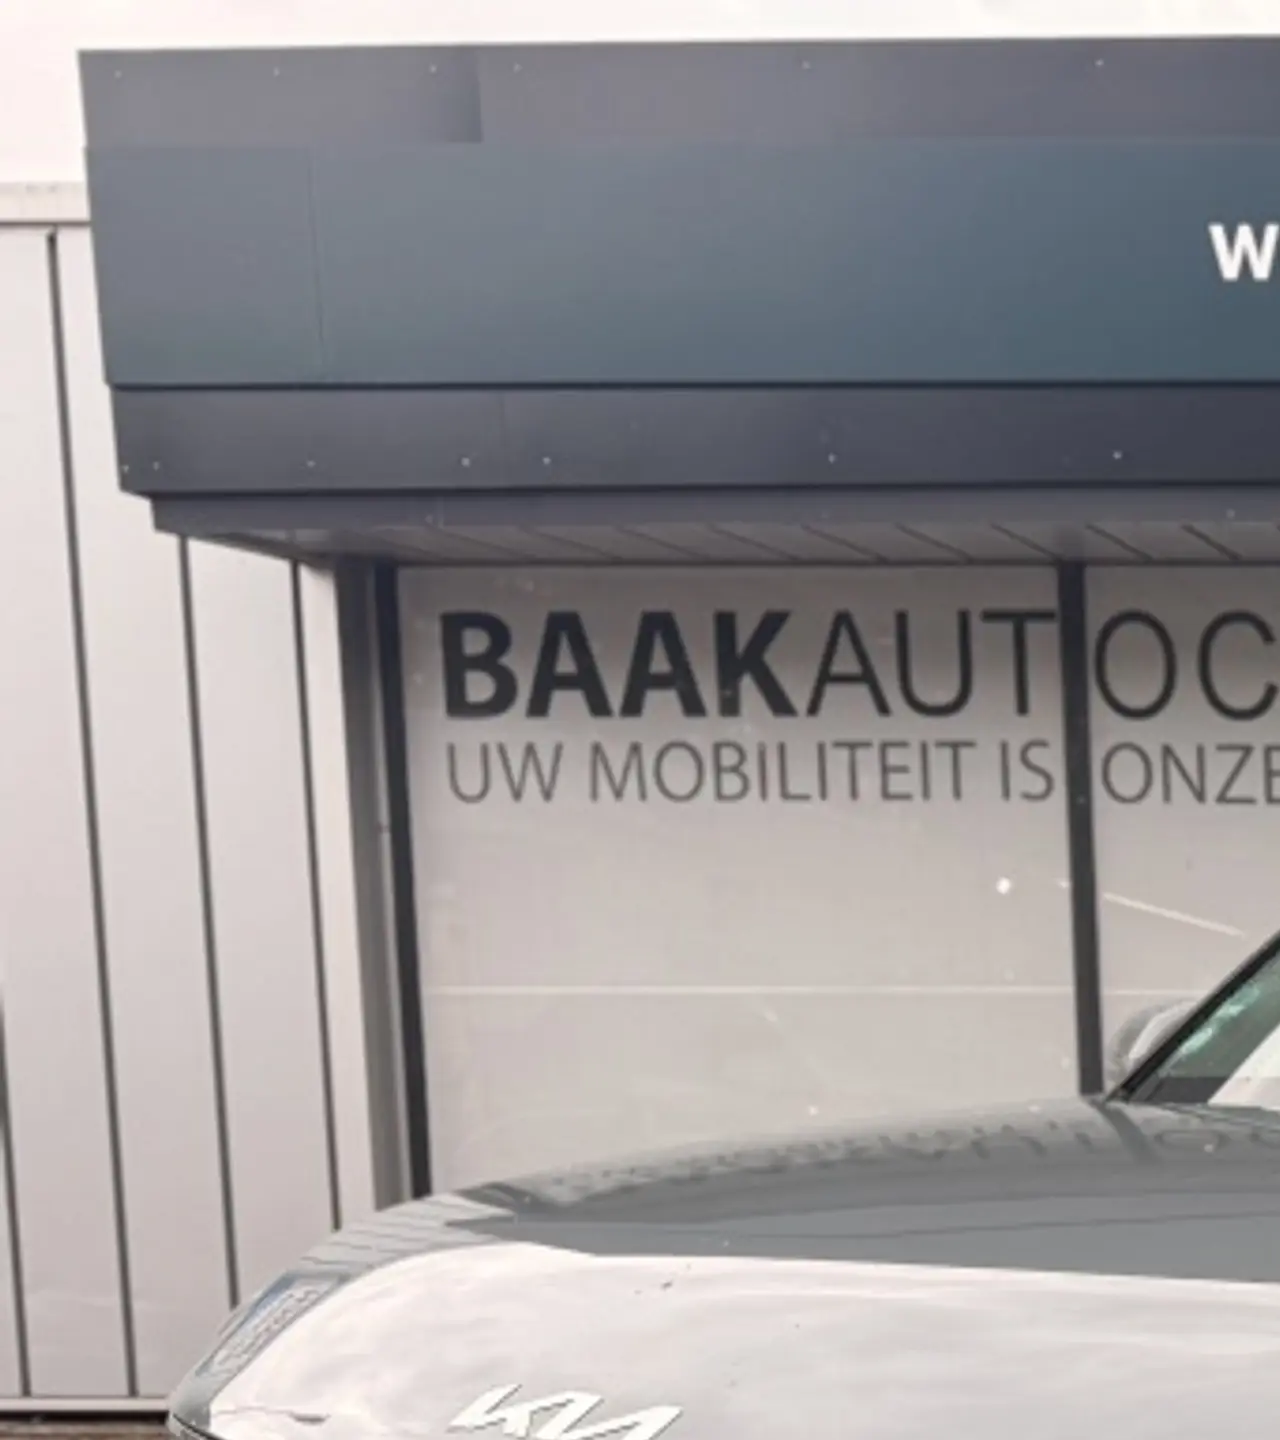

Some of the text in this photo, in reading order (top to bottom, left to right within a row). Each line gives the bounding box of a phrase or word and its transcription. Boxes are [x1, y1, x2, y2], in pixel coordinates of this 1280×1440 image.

[447, 741, 564, 804] UW
[590, 741, 977, 804] MOBILITEIT
[1000, 740, 1056, 803] IS
